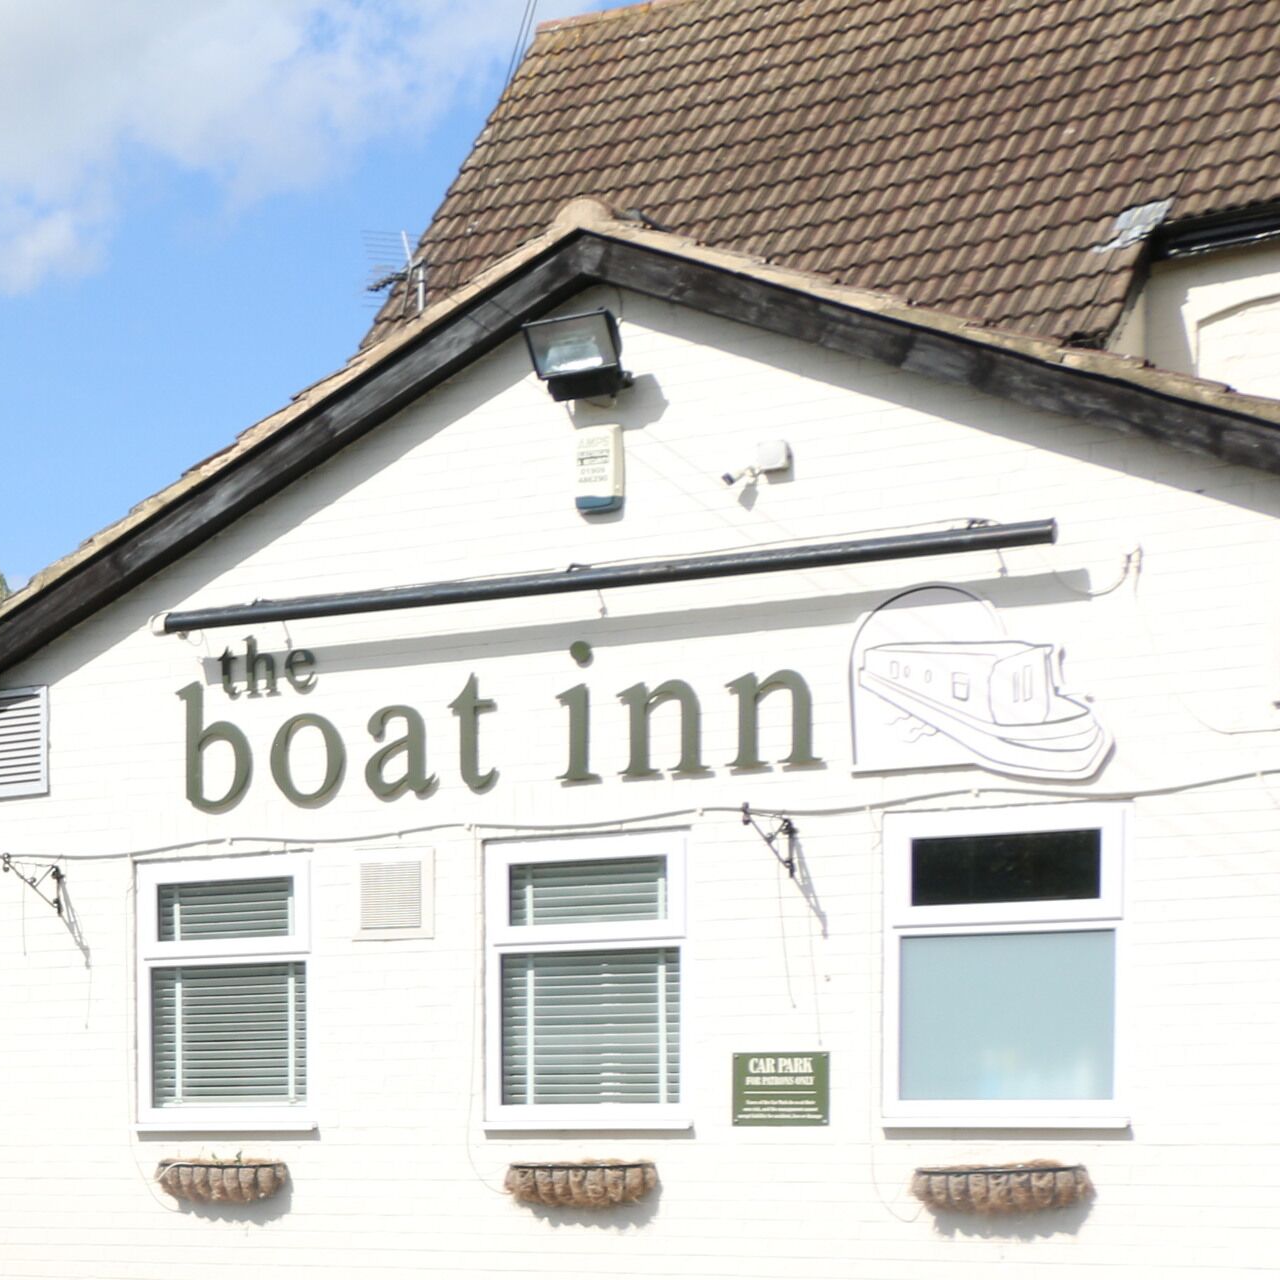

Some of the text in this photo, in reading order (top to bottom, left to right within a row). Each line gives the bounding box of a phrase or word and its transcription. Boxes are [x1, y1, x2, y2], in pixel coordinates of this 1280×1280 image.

[217, 635, 317, 698] the
[175, 640, 827, 814] boat inn
[748, 1057, 814, 1074] CAR PARK
